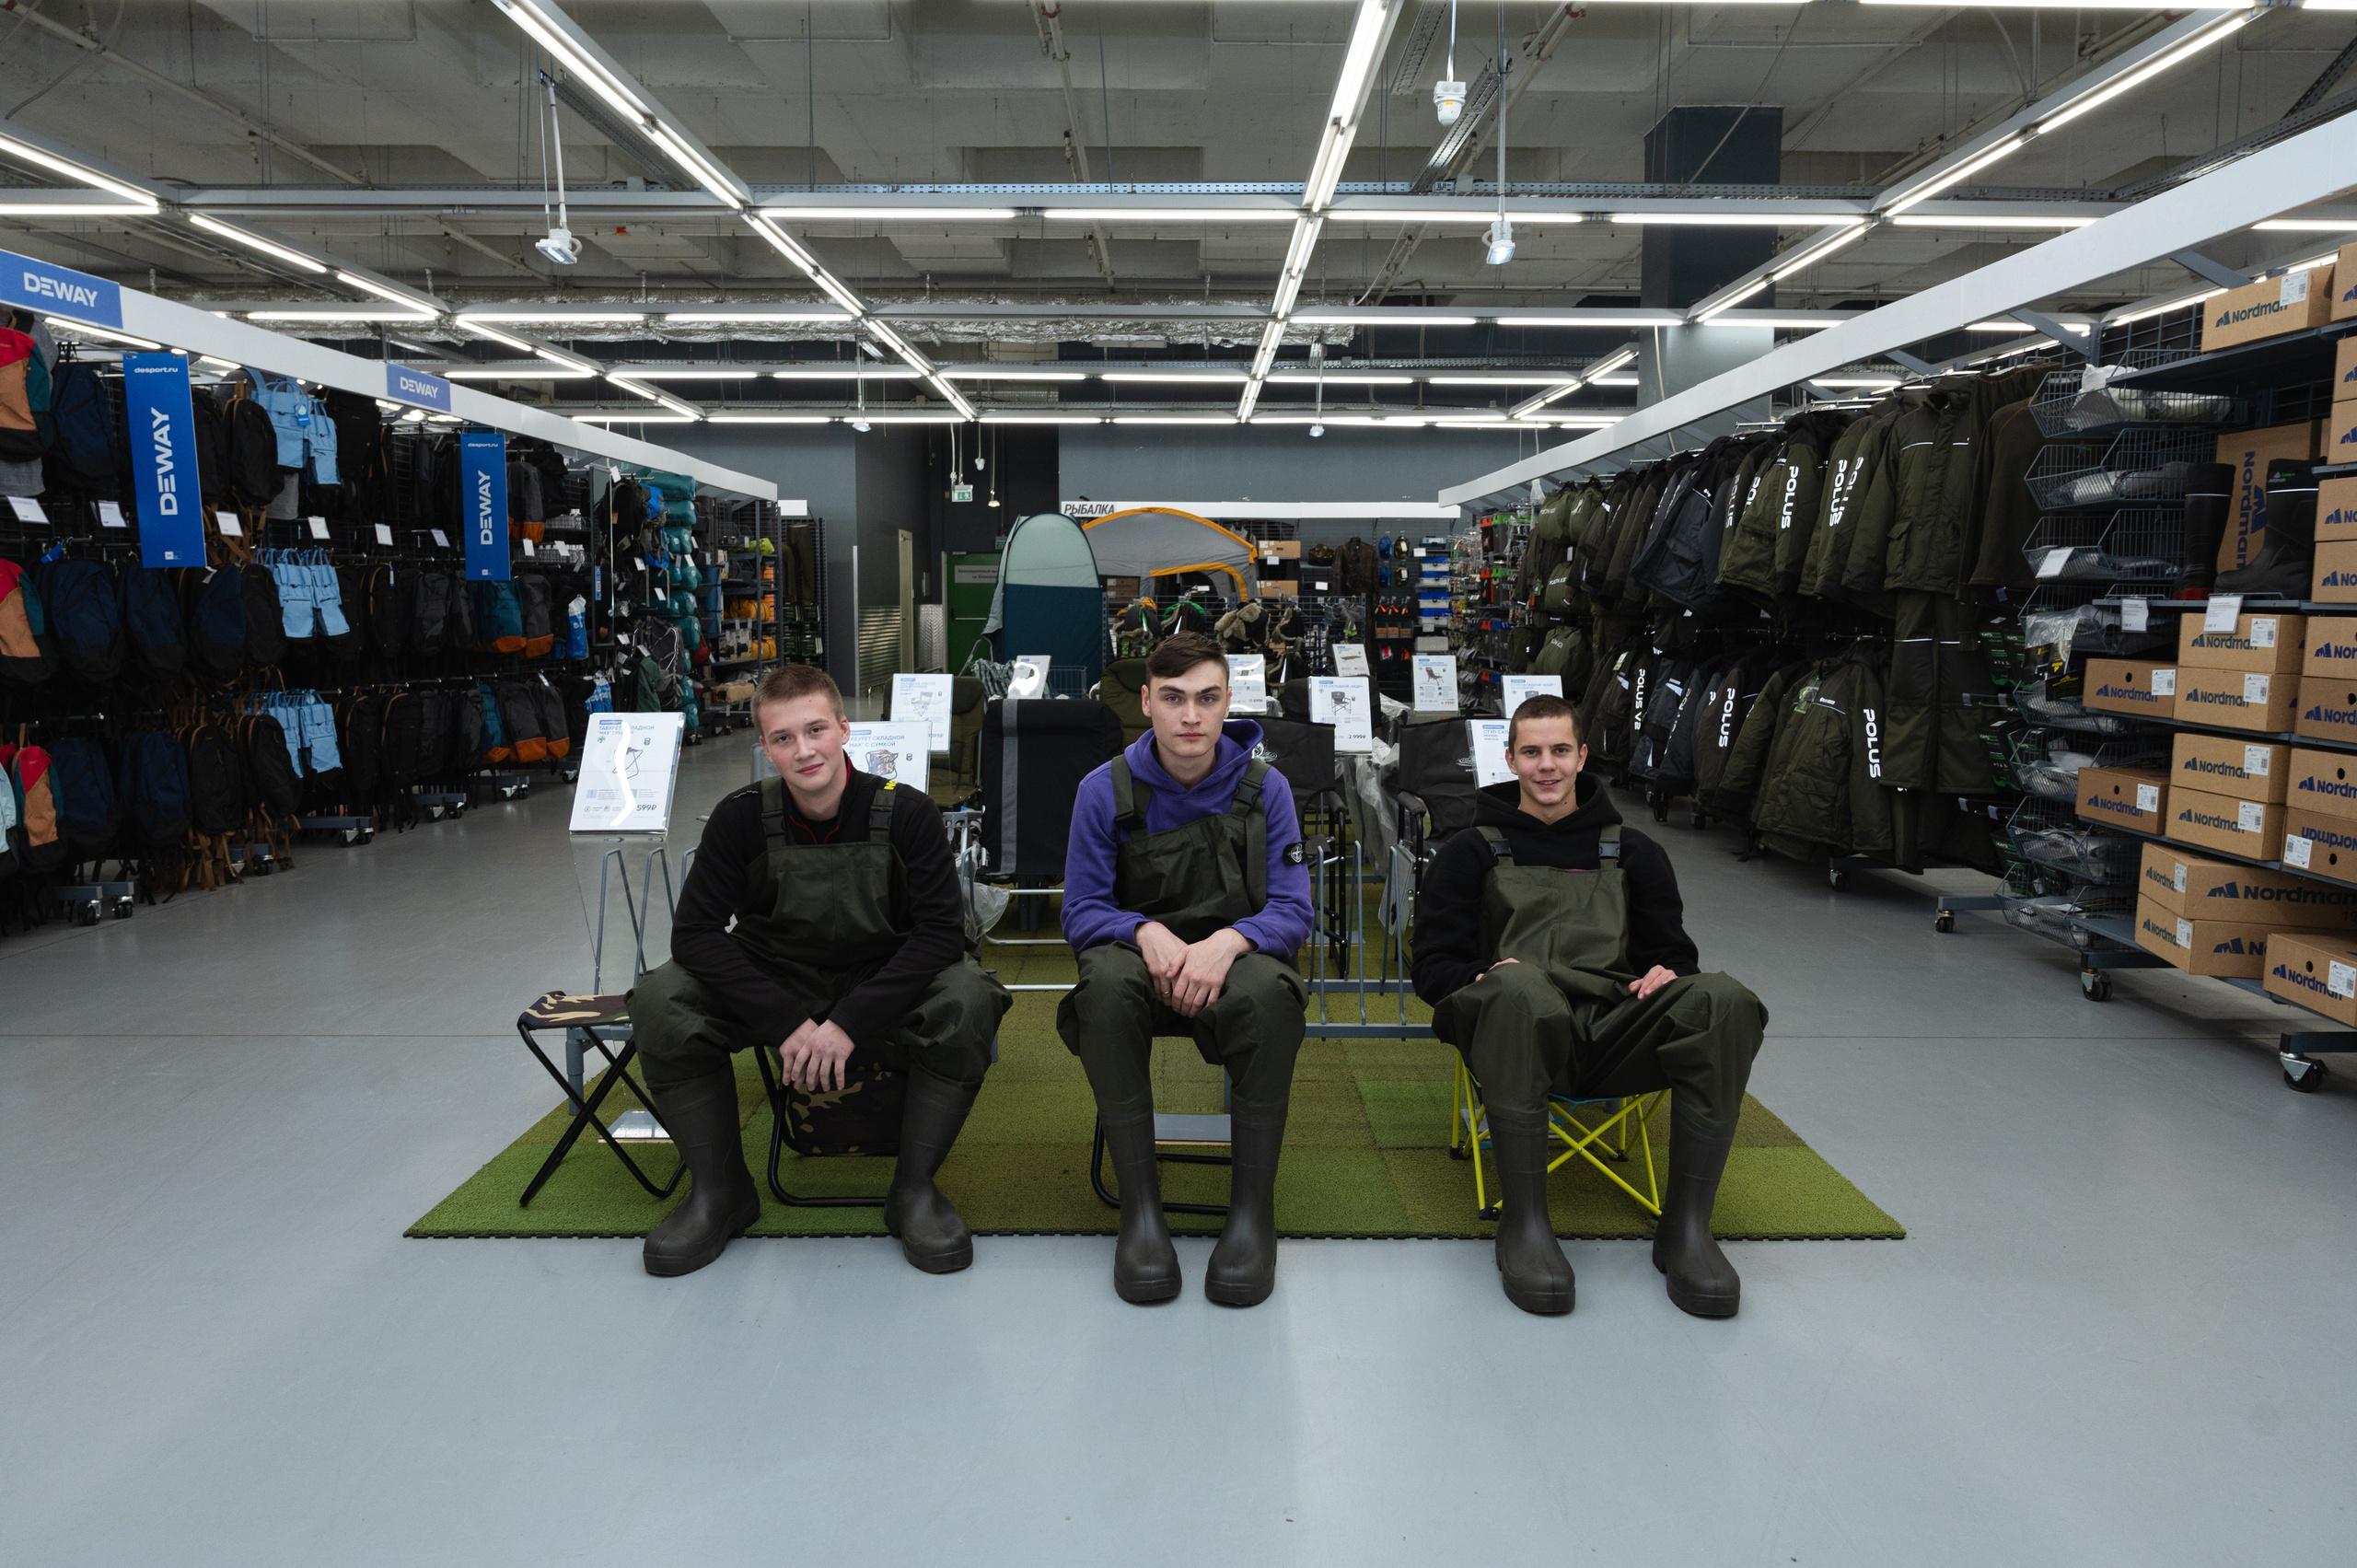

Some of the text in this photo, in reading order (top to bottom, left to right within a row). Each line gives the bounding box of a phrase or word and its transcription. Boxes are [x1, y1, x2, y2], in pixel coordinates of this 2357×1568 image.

[23, 272, 99, 308] DEWAY
[134, 366, 179, 375] desport.ru
[400, 377, 439, 399] DEWAY
[150, 406, 179, 516] DEWAY
[477, 470, 493, 545] DEWAY
[1064, 504, 1115, 515] РЫБАЛКА
[1725, 473, 1740, 528] POLUS
[1781, 465, 1800, 529] POLUS
[1829, 459, 1848, 528] POLUS
[2236, 451, 2255, 568] Nordman
[2206, 635, 2258, 650] Nordma
[1634, 668, 1645, 730] POLUS V2
[1719, 688, 1736, 748] POLUS
[1863, 708, 1881, 779] POLUS
[2152, 869, 2177, 893] Nordma
[2151, 922, 2181, 948] Nordma
